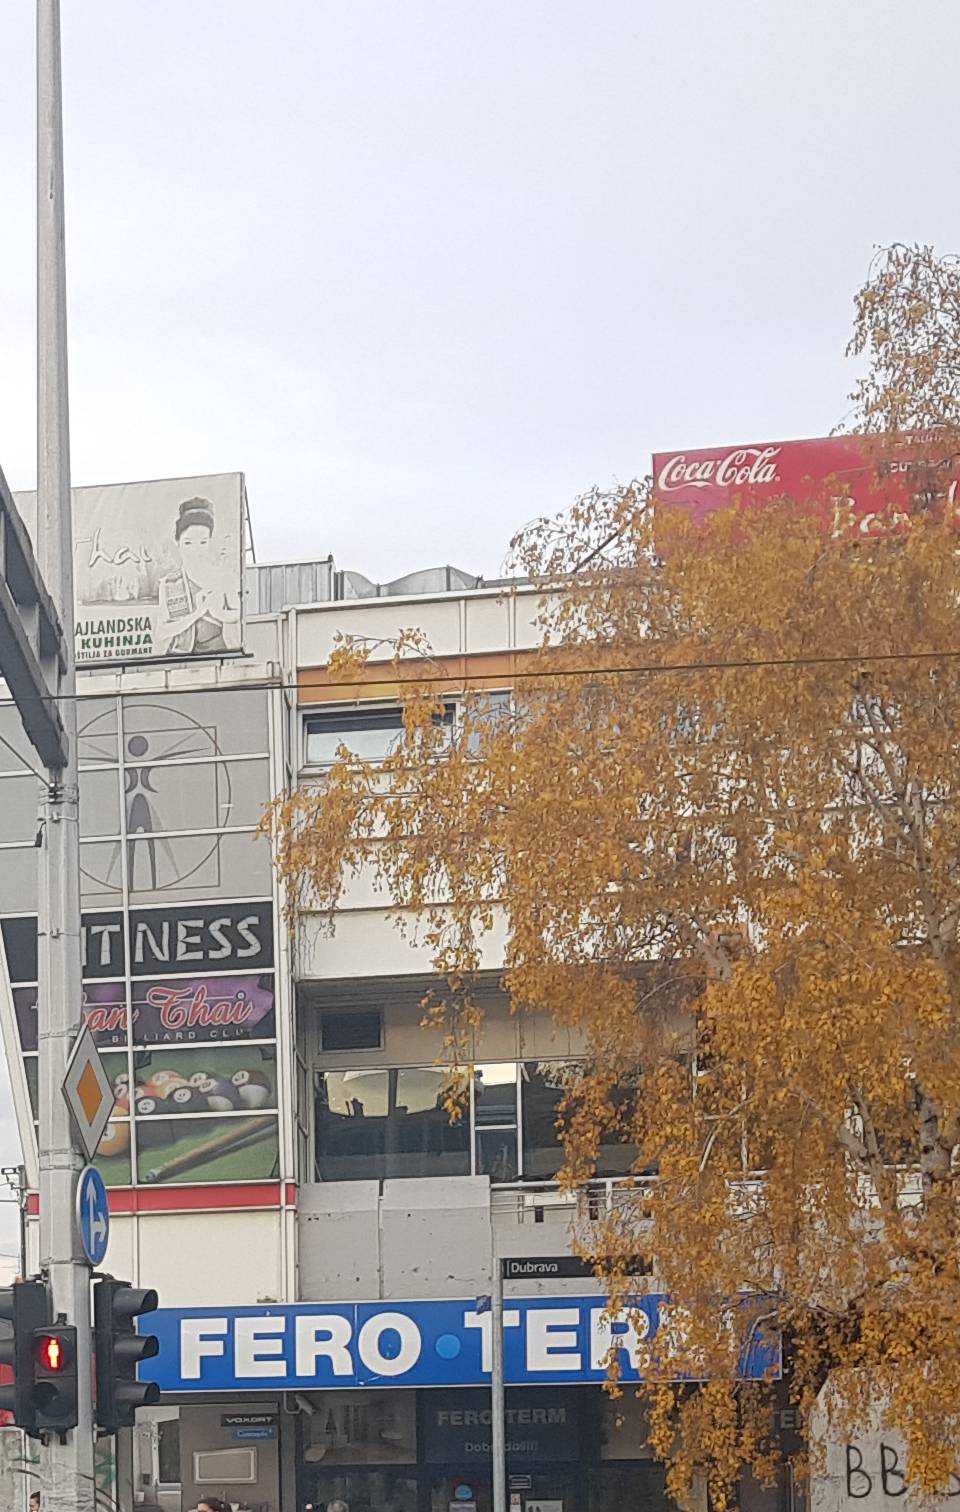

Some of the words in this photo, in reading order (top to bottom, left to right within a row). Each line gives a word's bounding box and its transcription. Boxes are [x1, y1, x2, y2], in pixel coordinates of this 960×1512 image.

[75, 616, 152, 636] AJLANDSKA
[81, 634, 153, 649] KUHINJA
[81, 916, 262, 967] ITNESS
[146, 984, 253, 1030] Thai
[111, 1031, 196, 1044] BILIARD
[511, 1262, 559, 1274] Dubrava
[180, 1312, 422, 1380] FERO
